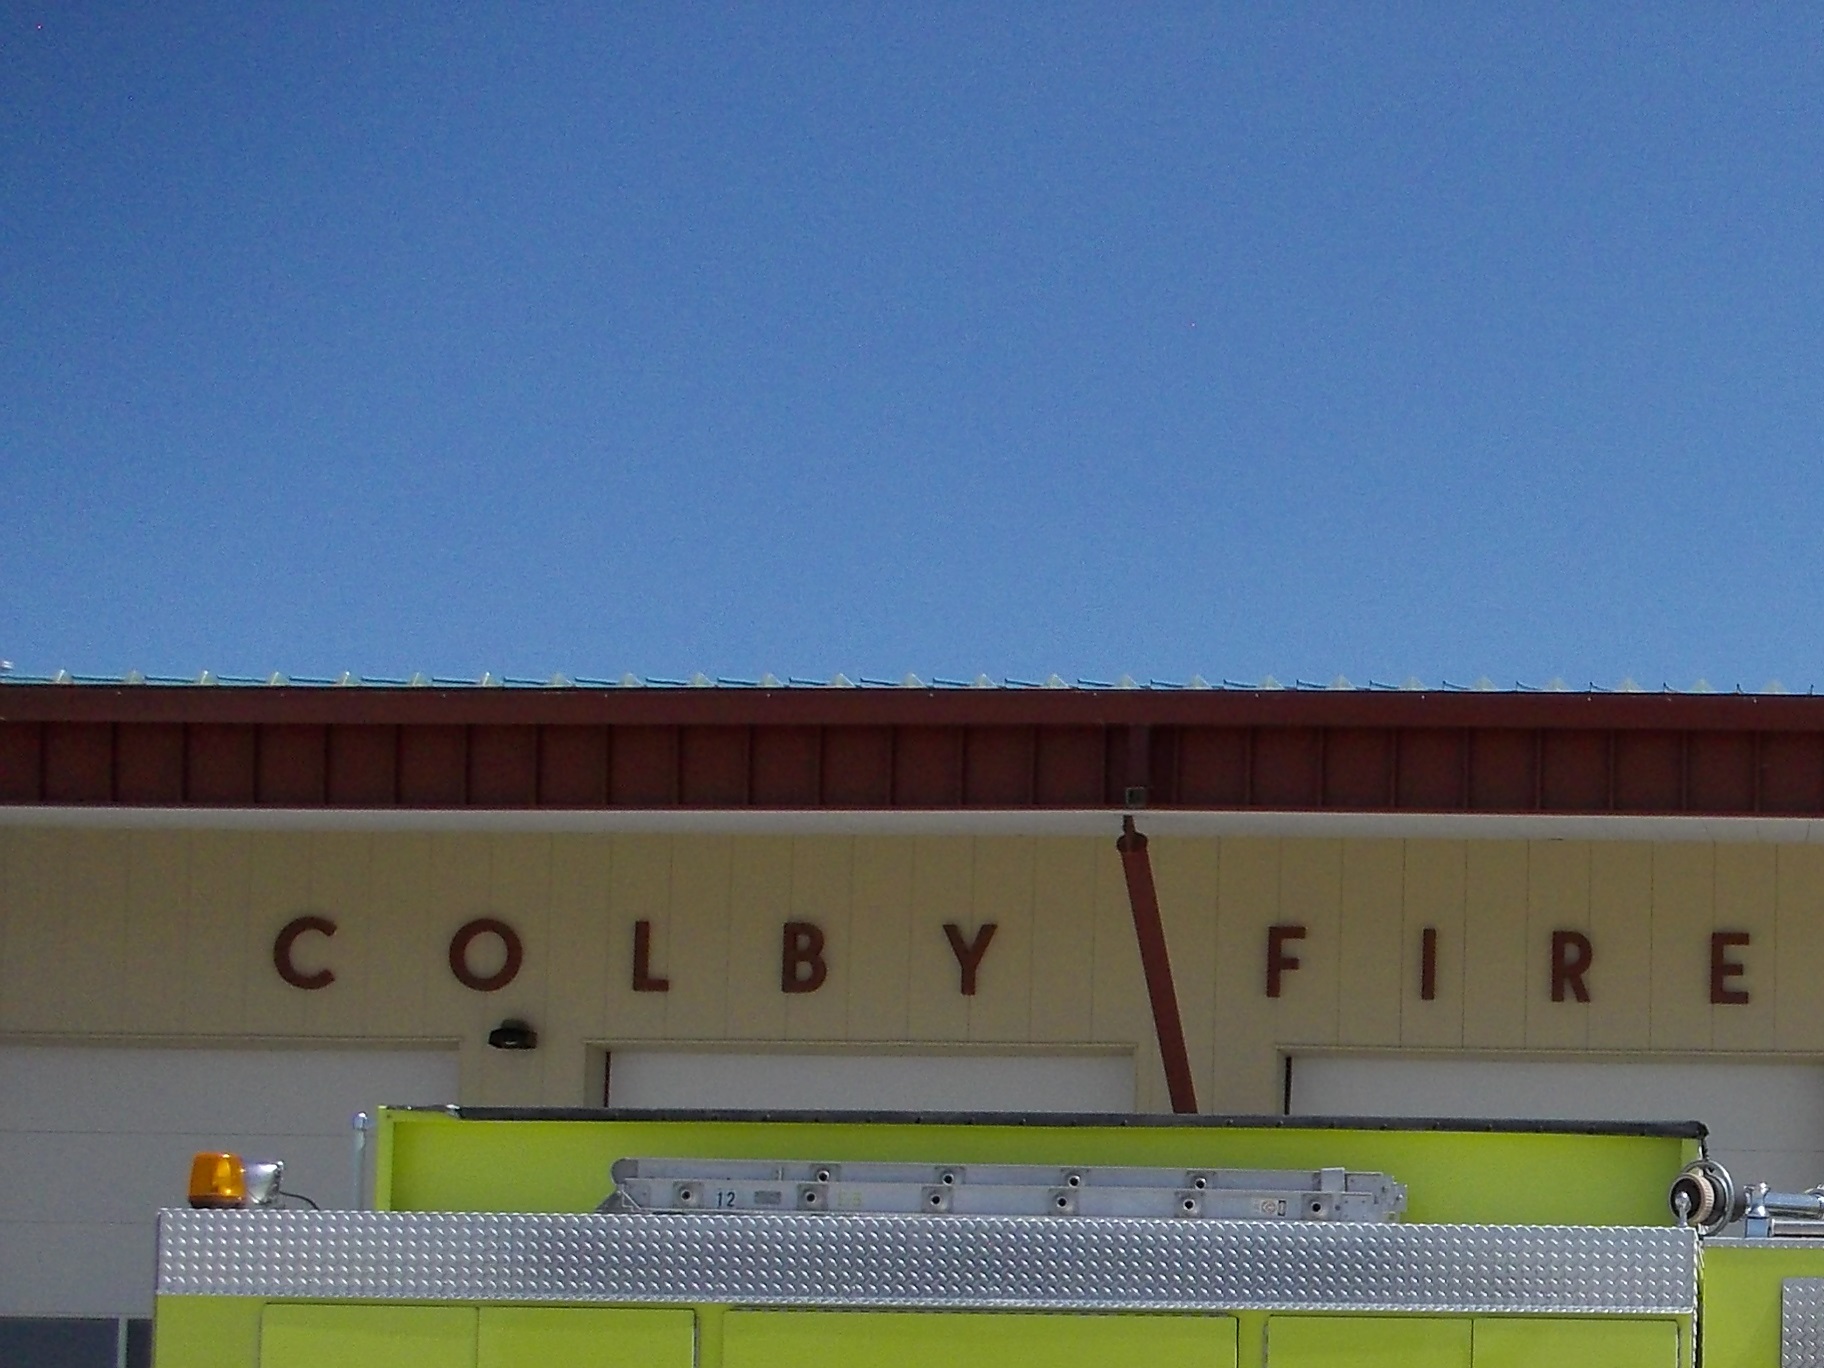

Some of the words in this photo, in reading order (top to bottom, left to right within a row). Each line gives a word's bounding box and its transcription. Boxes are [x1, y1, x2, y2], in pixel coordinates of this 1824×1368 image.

[275, 917, 997, 996] COLBY
[1266, 922, 1749, 1005] FIRE
[716, 1192, 736, 1207] 12
